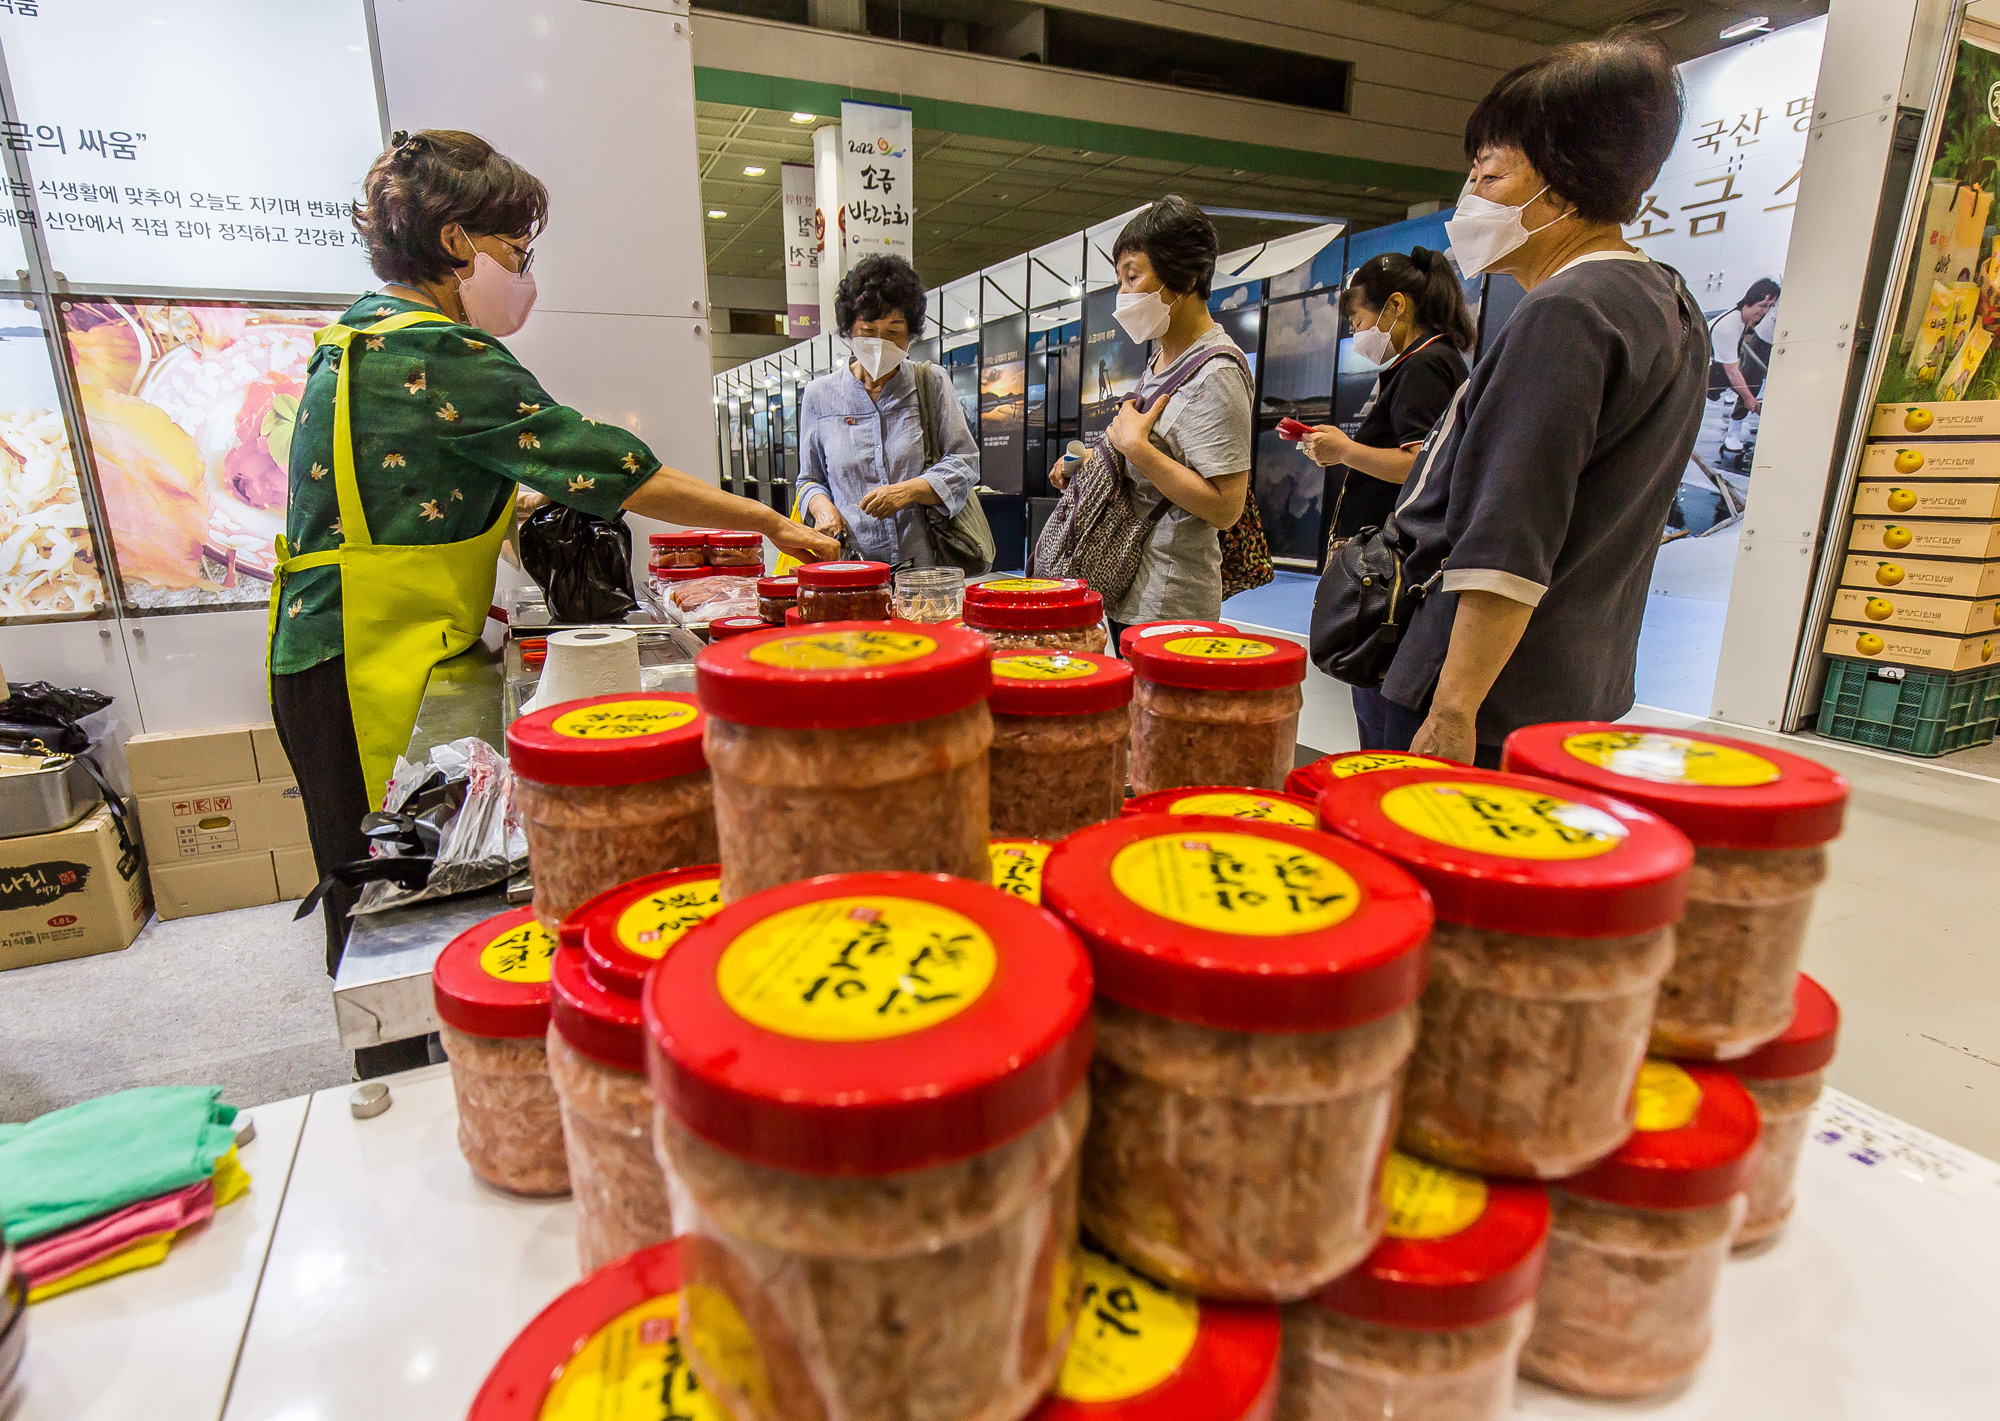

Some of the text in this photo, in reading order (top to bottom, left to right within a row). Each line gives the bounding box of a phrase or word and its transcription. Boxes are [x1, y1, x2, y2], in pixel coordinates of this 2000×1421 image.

[0, 120, 67, 155] 금의
[848, 140, 875, 154] 2022
[1692, 107, 1769, 155] 국산
[861, 165, 895, 194] 소금
[38, 180, 119, 204] 식생활에
[124, 186, 182, 208] 맞추어
[189, 192, 243, 211] 오늘도
[249, 196, 301, 216] 지키며
[848, 200, 909, 226] 박람회
[1625, 173, 1743, 241] 소금
[45, 211, 125, 235] 신안에서
[131, 217, 169, 237] 직접
[175, 220, 212, 239] 잡아
[218, 223, 289, 243] 정직하고
[294, 228, 345, 247] 건강한
[0, 869, 47, 894] 나리
